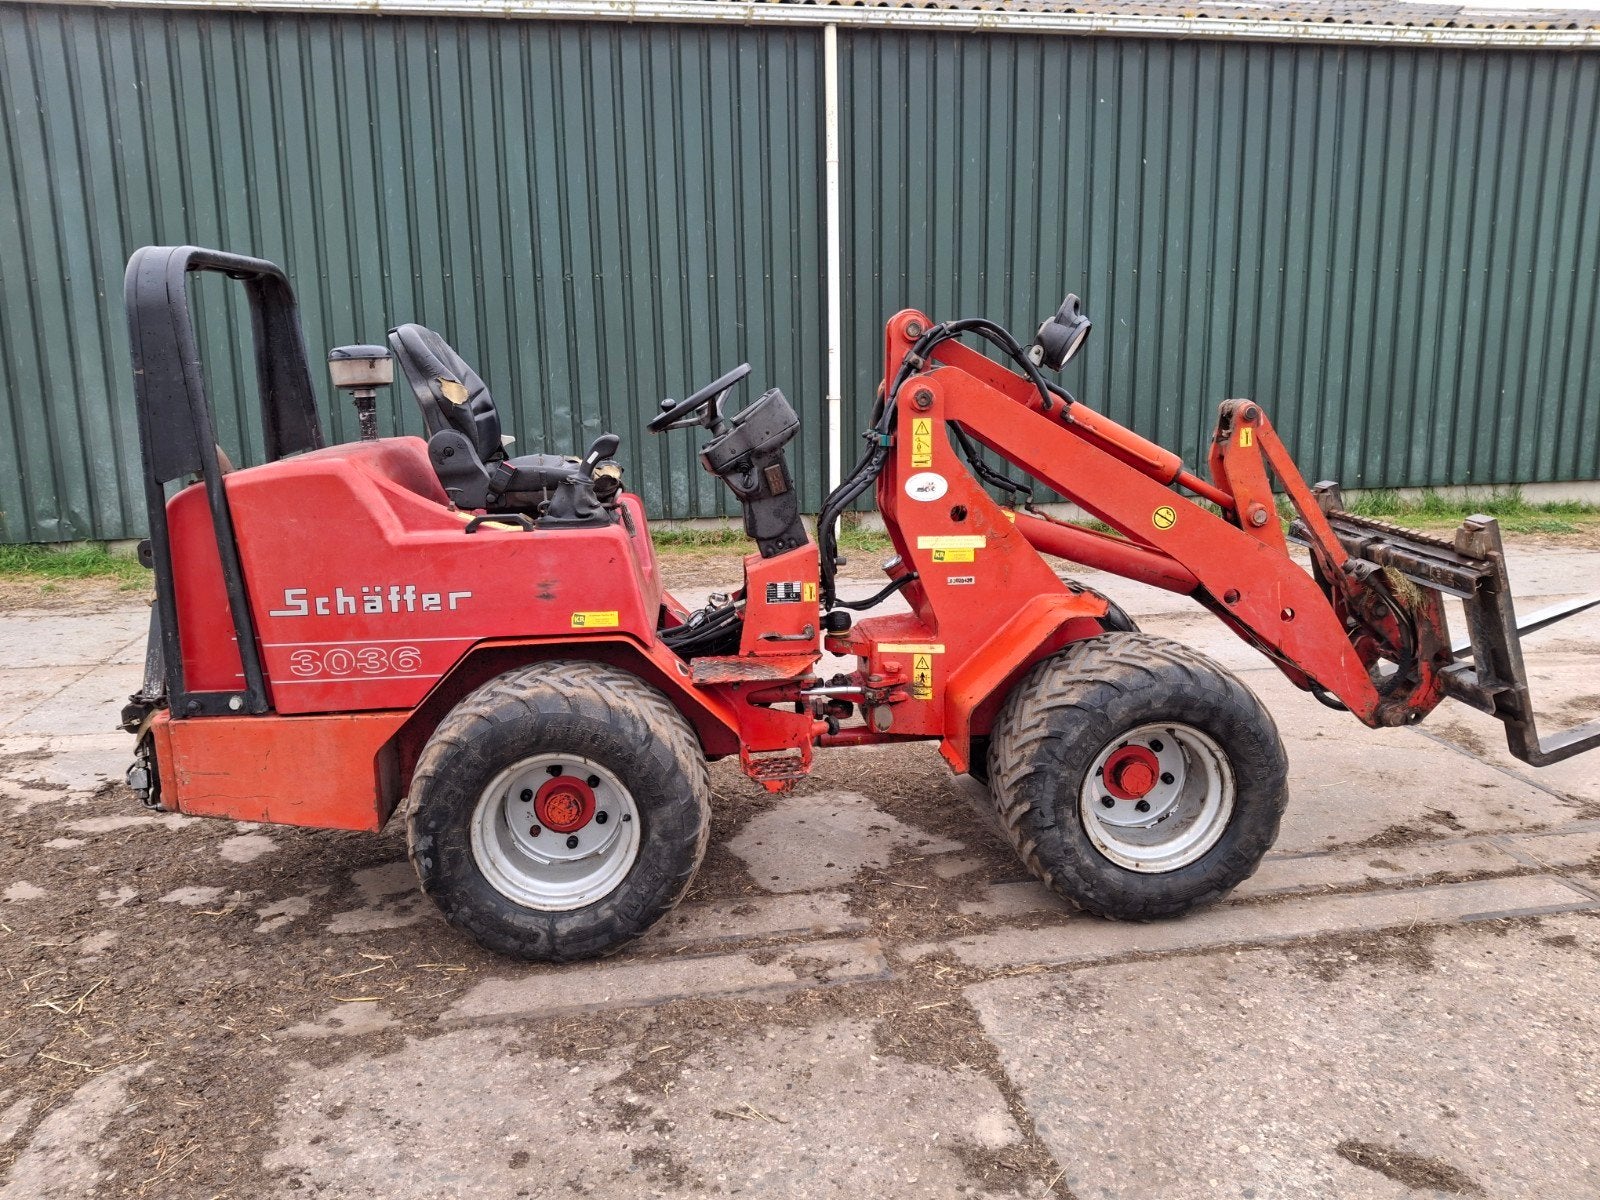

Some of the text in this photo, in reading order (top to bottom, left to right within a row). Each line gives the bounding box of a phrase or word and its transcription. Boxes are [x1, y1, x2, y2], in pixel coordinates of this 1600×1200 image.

[269, 585, 472, 616] Schäffer
[574, 615, 585, 623] KR
[290, 646, 422, 676] 3036
